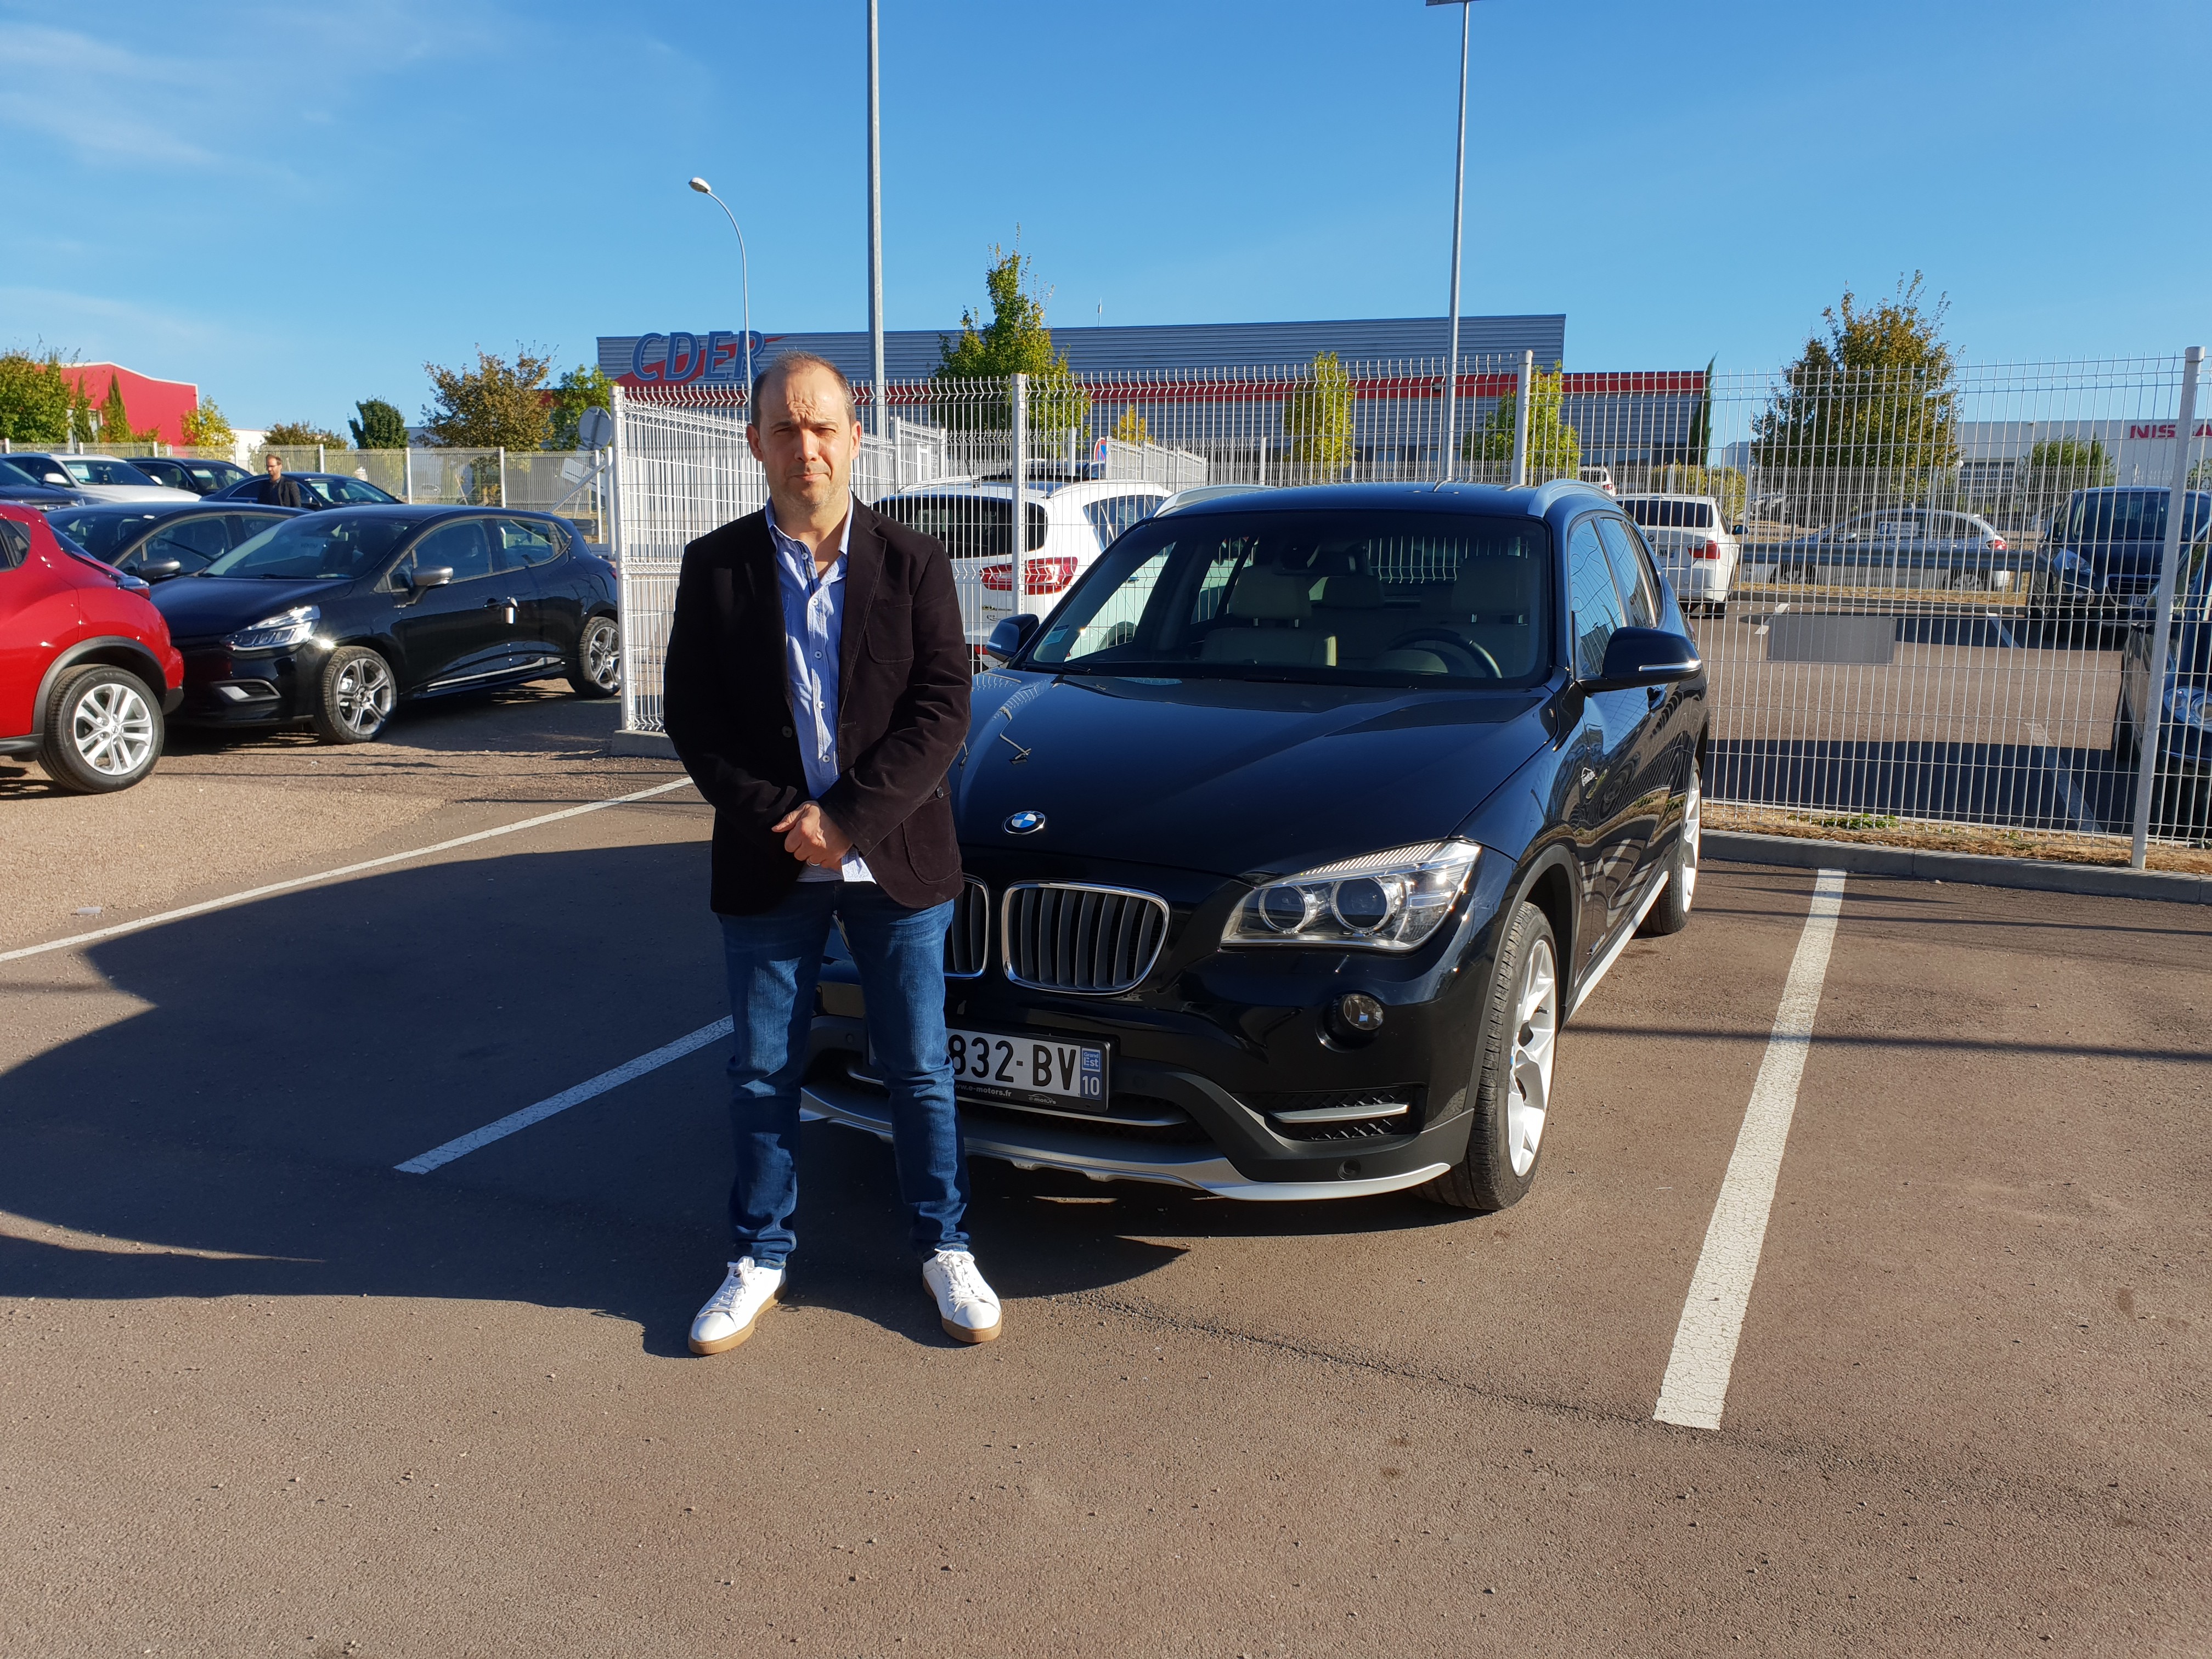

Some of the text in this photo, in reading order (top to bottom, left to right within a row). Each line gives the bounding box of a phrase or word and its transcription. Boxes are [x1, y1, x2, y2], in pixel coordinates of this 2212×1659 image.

[632, 331, 766, 381] CDER
[2130, 424, 2212, 438] NISA
[948, 1035, 1076, 1091] 832-BV
[1084, 1057, 1099, 1067] Est
[1082, 1075, 1099, 1096] 10
